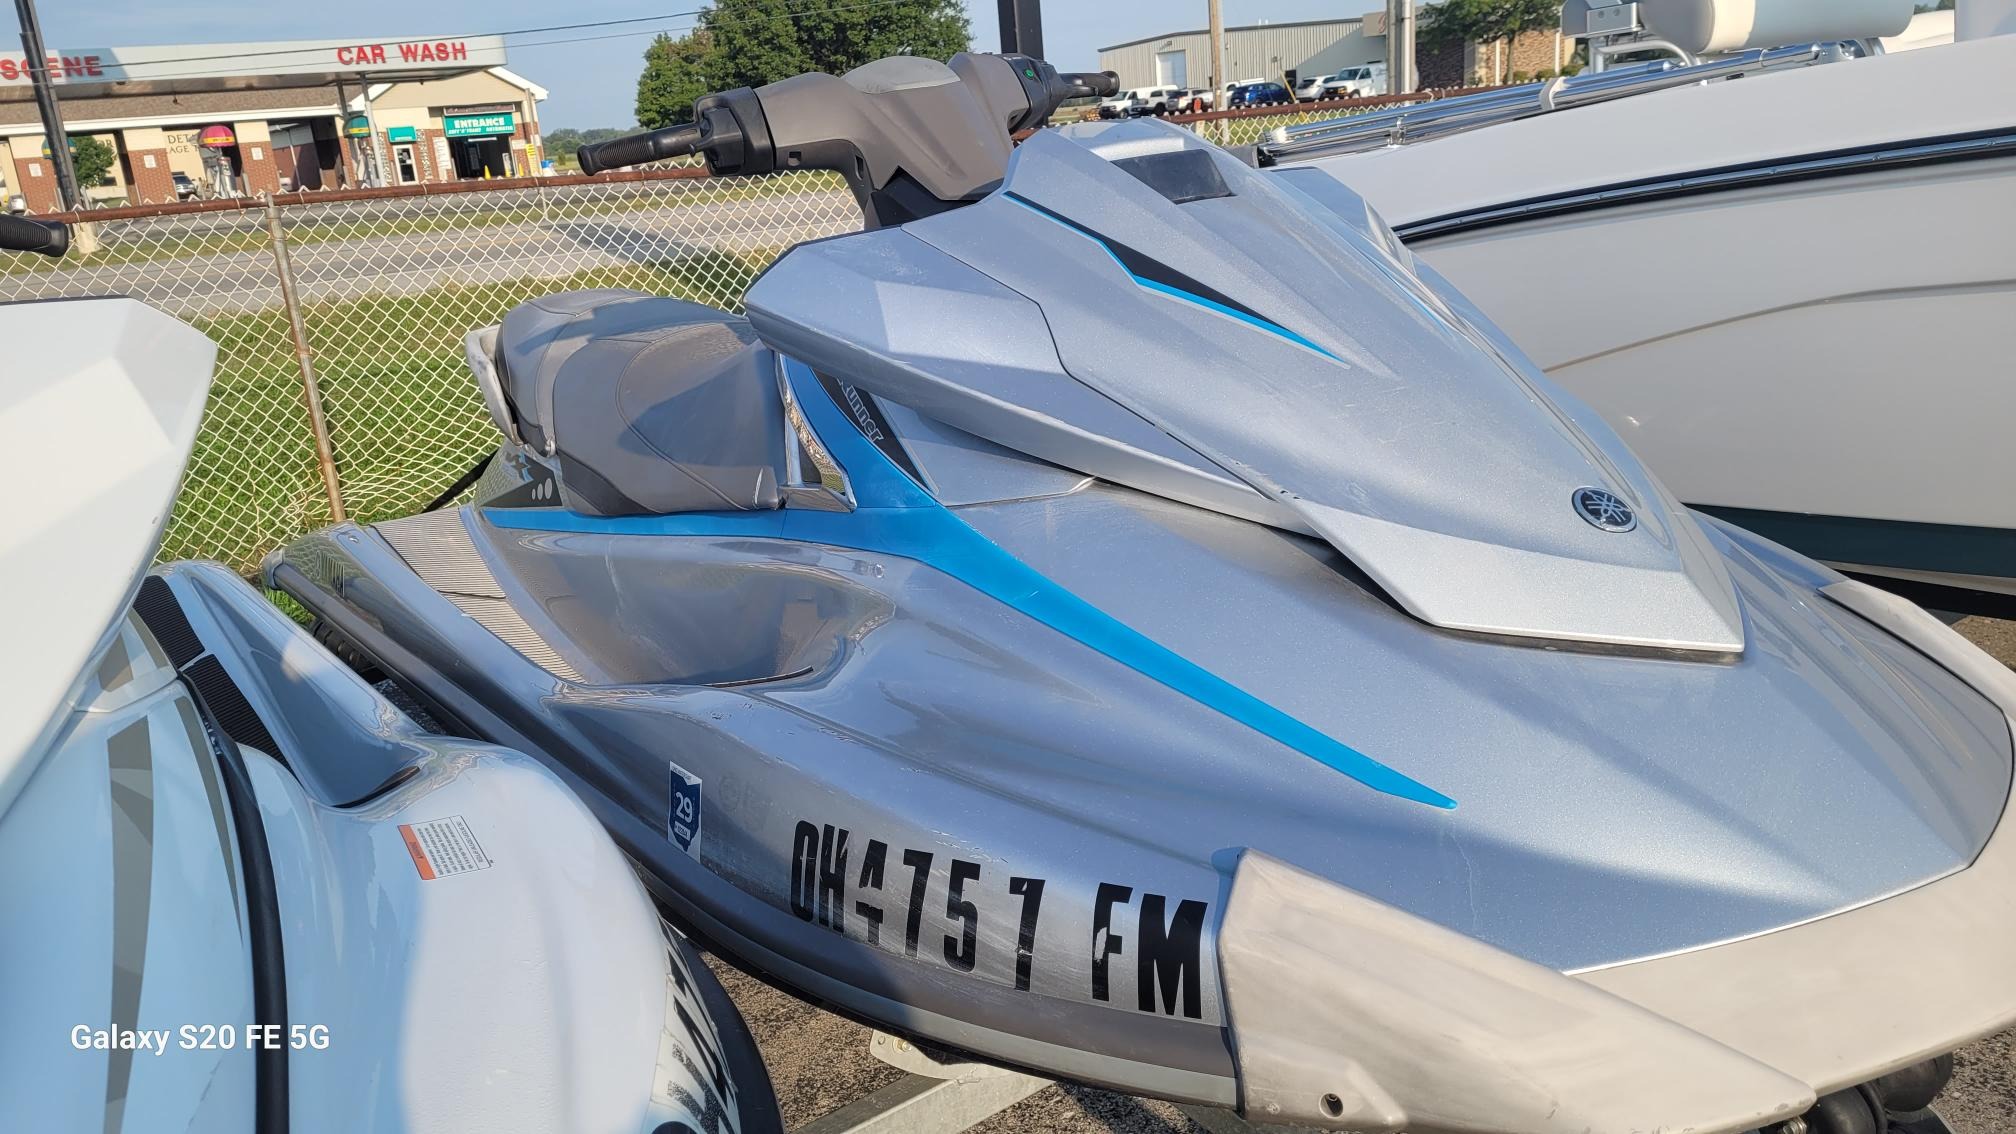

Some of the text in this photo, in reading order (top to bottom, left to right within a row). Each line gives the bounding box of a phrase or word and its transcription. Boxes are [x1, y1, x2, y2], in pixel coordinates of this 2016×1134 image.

[337, 42, 467, 65] CAR WASH
[453, 117, 505, 129] ENTRANCE
[675, 791, 693, 823] 29
[1092, 882, 1208, 1019] FM
